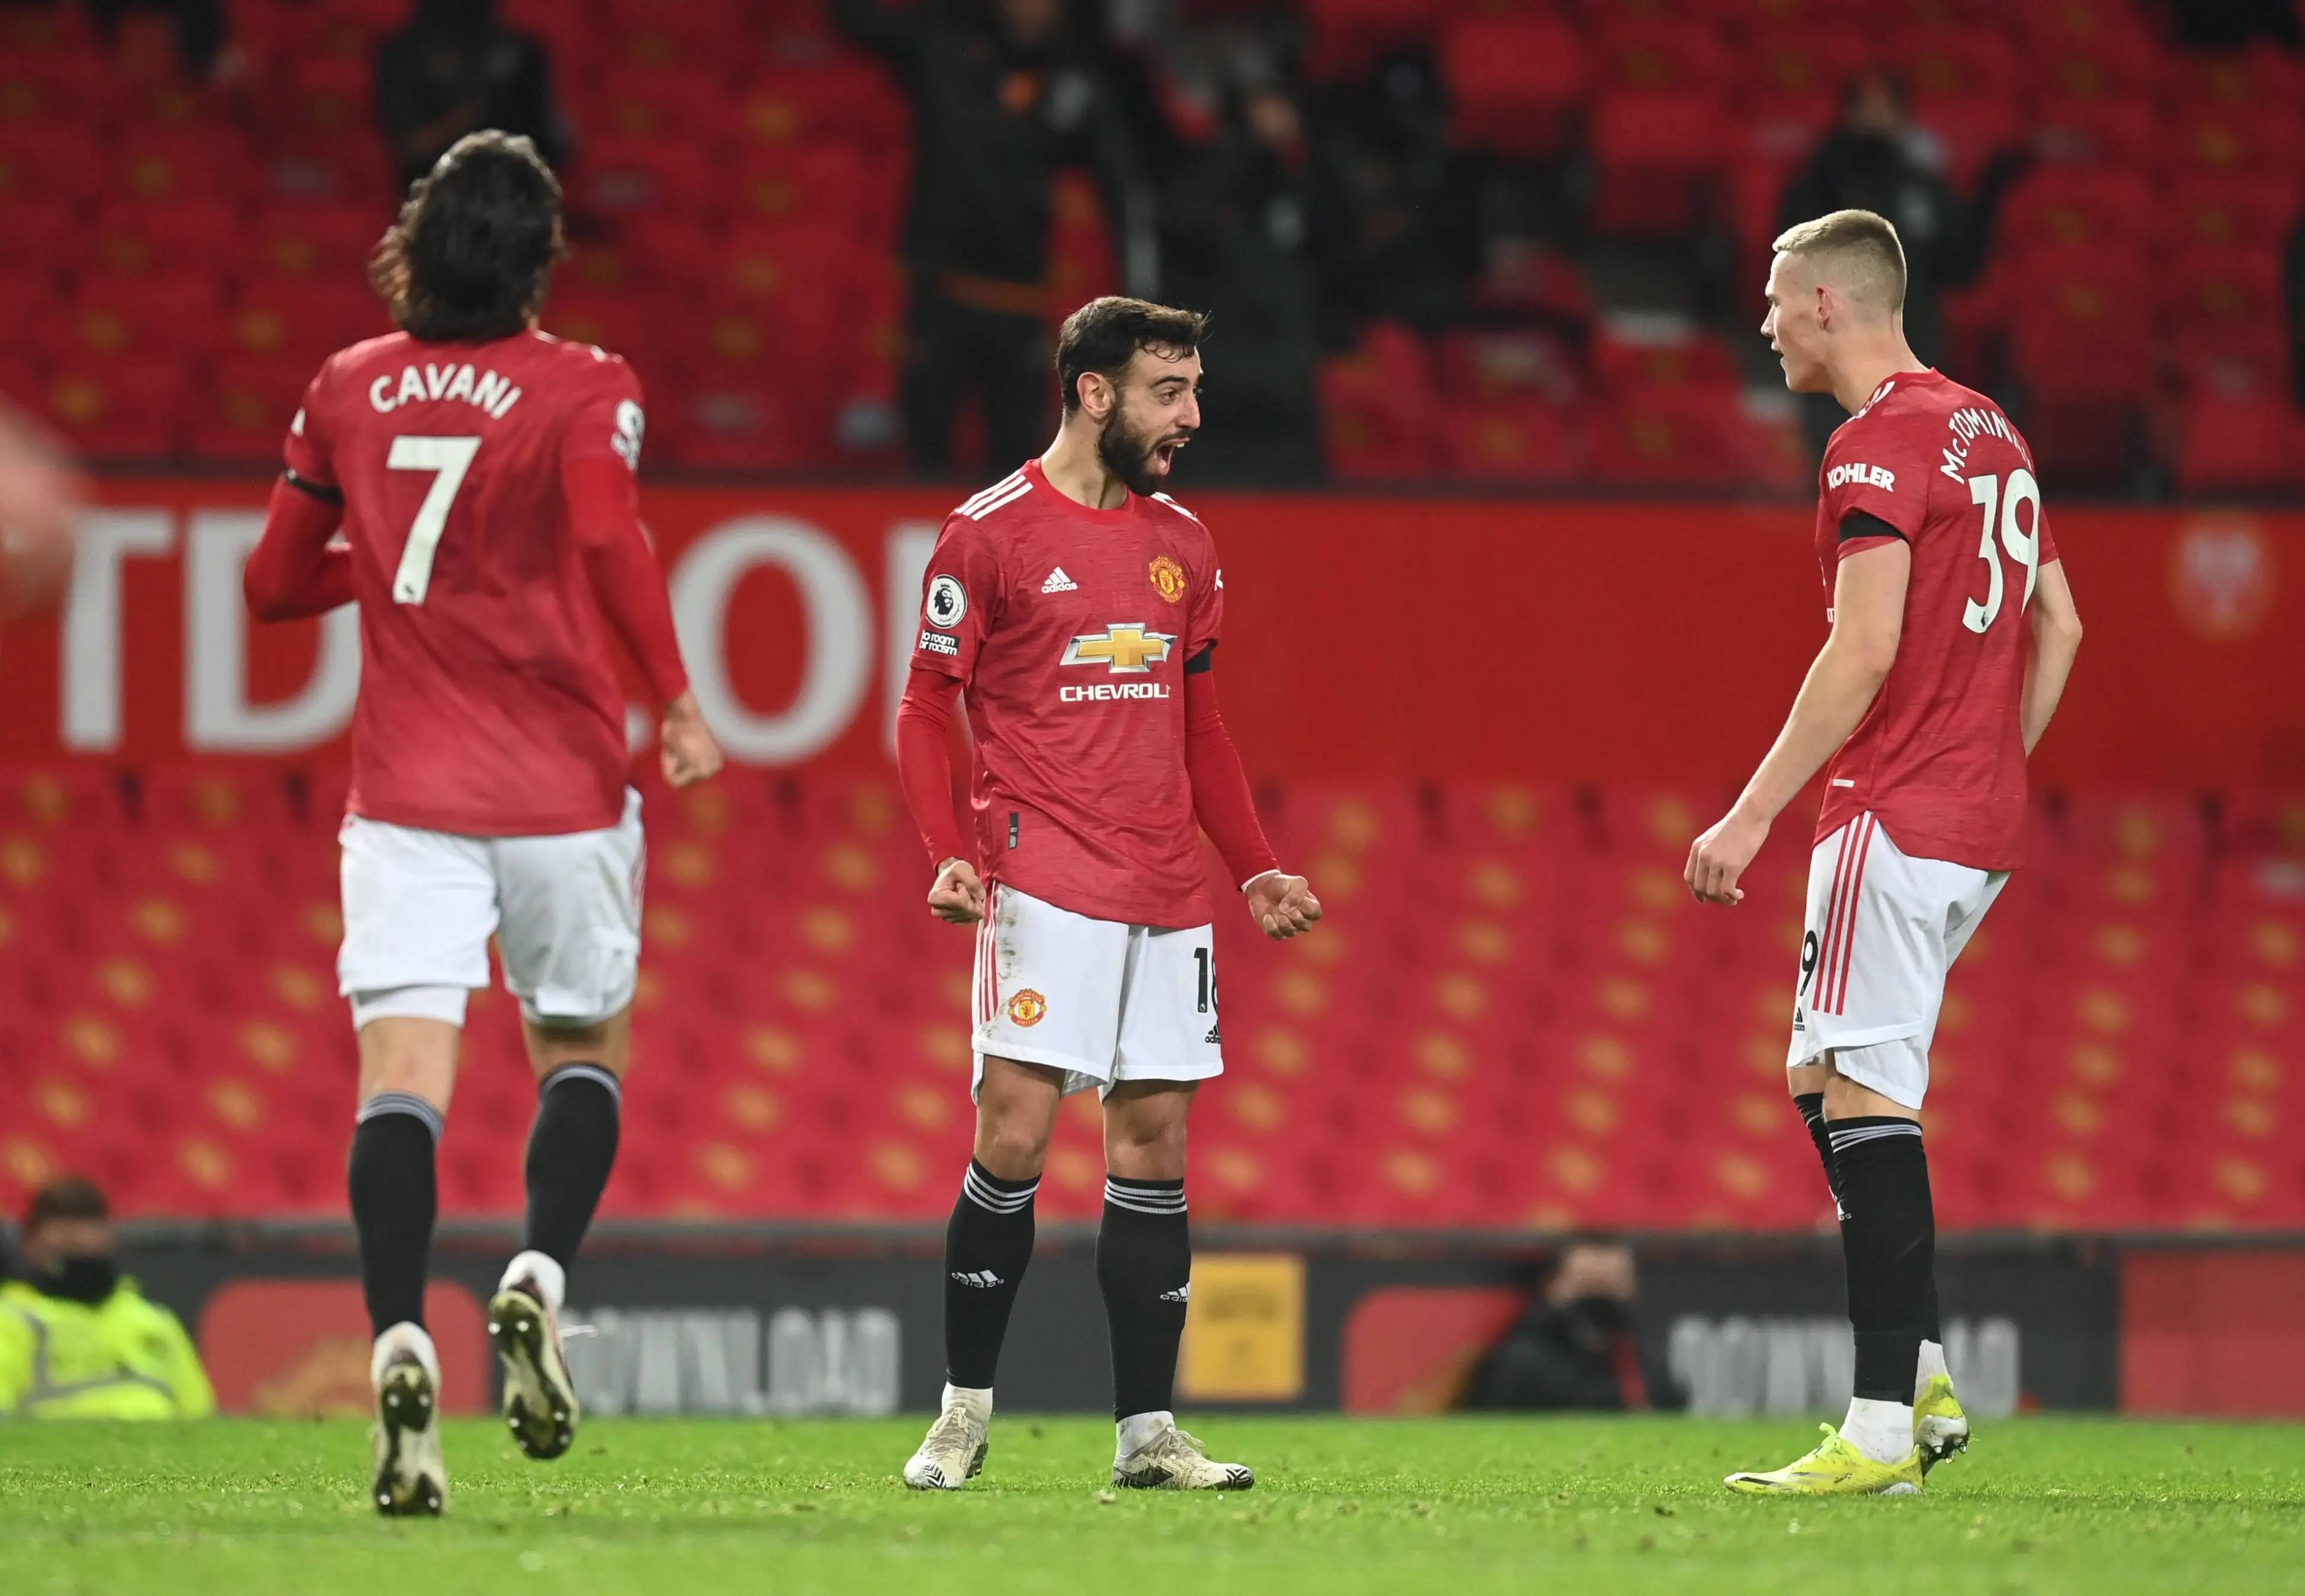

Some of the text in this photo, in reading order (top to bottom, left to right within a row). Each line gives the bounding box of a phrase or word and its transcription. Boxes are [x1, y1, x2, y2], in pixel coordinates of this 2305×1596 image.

[369, 363, 522, 420] CAVANI
[1940, 407, 2032, 485] McTOMIN
[1827, 463, 1895, 492] KOHLER
[387, 435, 482, 605] 7
[1963, 468, 2040, 633] 39
[1041, 581, 1078, 594] adidas
[919, 640, 929, 649] or
[931, 633, 955, 646] room
[1060, 683, 1171, 702] CHEVROL
[1160, 1294, 1190, 1303] adid
